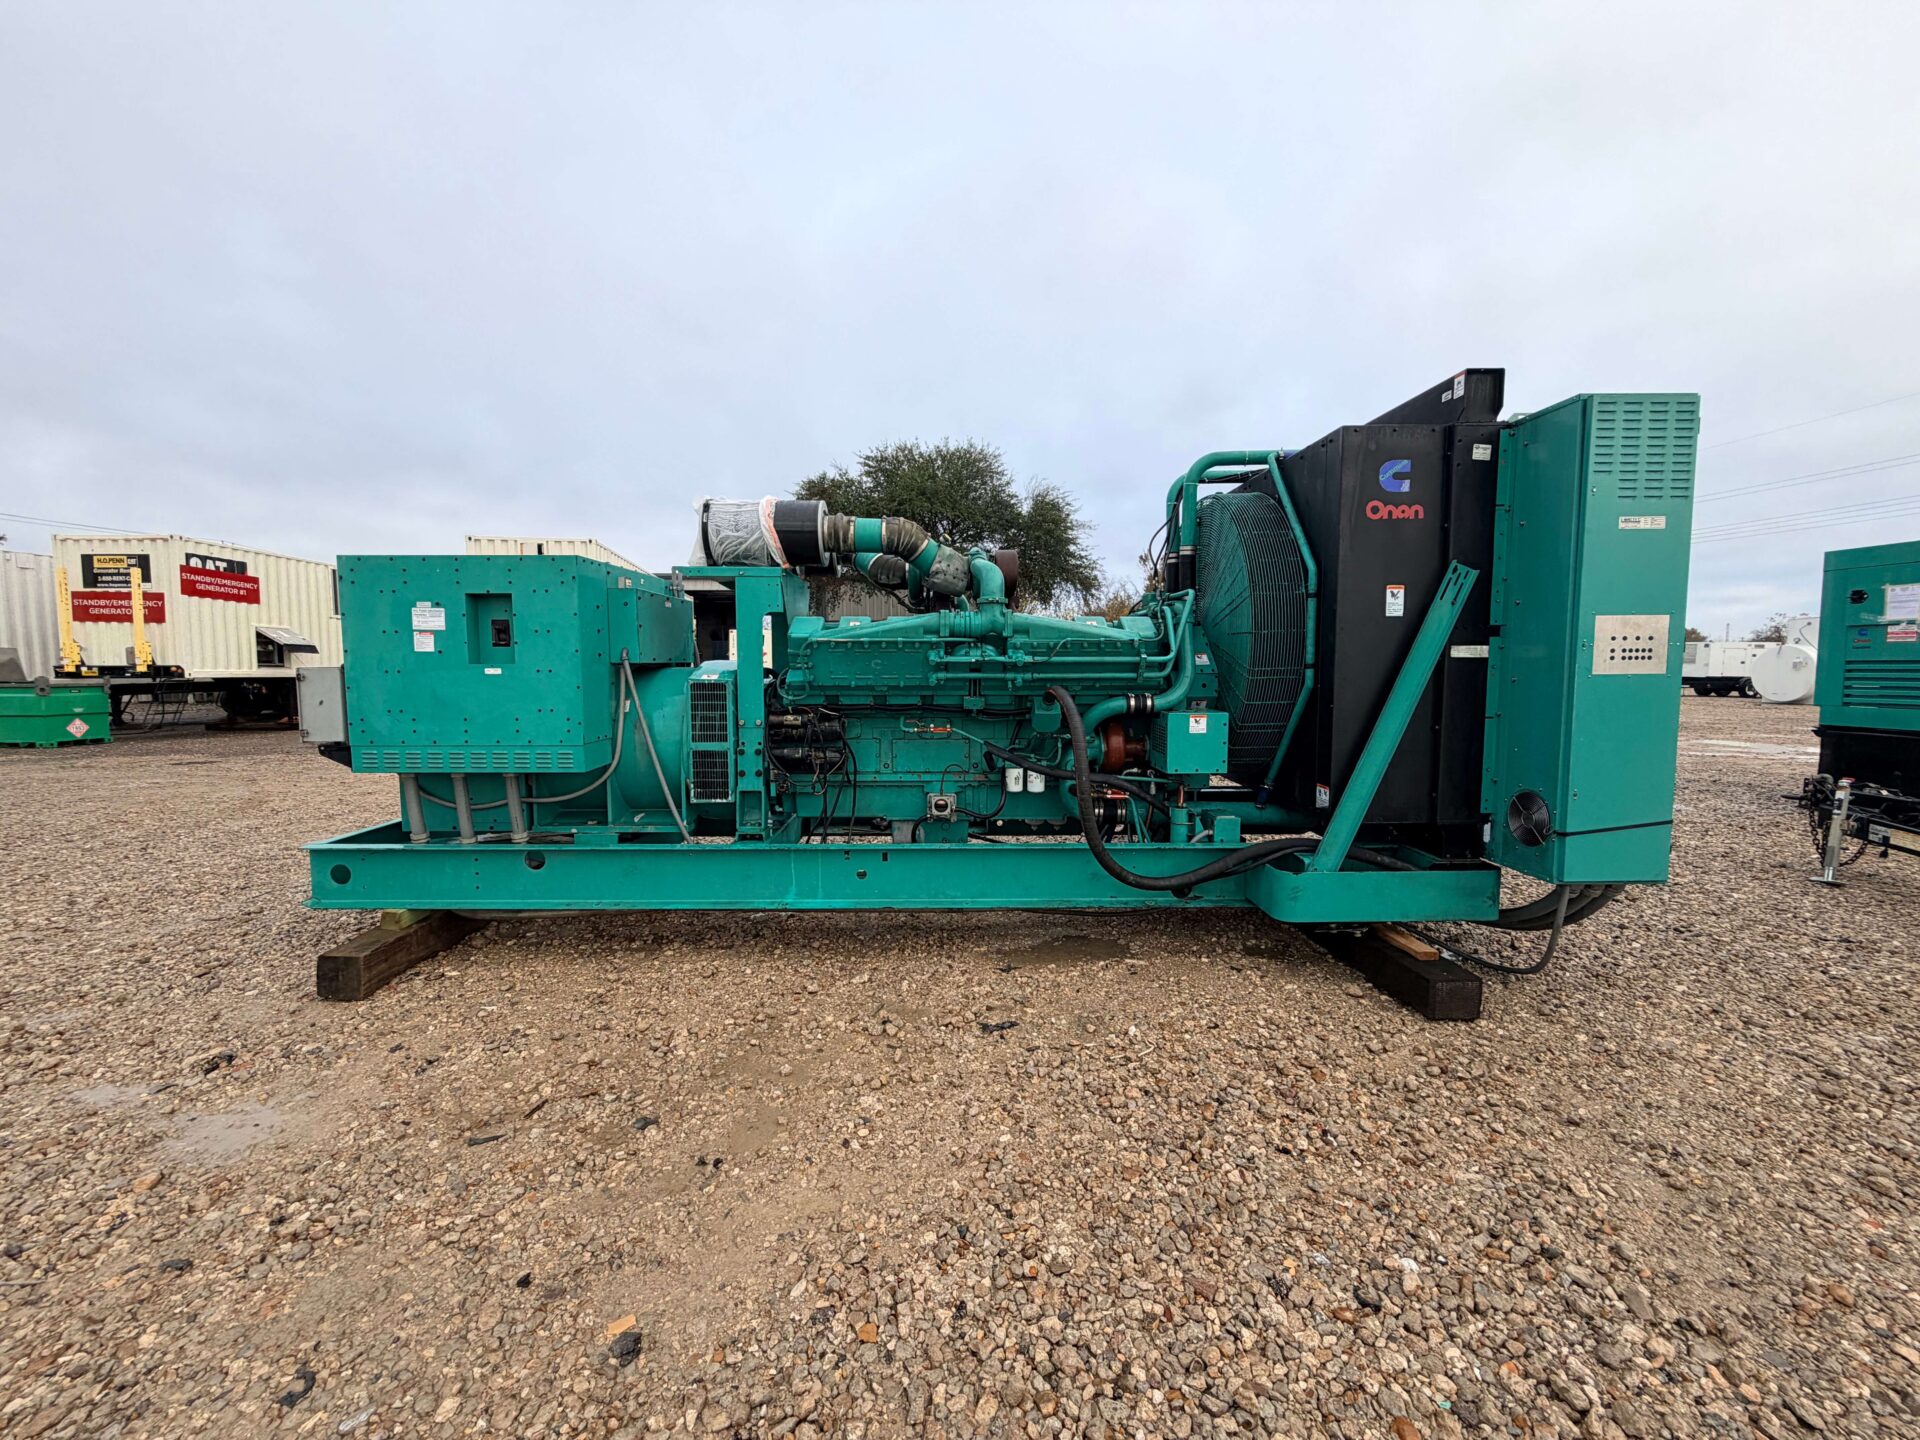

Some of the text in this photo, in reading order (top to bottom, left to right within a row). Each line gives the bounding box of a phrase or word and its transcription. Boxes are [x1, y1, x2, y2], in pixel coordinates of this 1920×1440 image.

[1365, 500, 1424, 520] Onan
[181, 573, 258, 589] STANDBY/EMERGENCY
[195, 583, 239, 594] GENERATOR
[73, 599, 163, 607] STANDBY/EMERENCY
